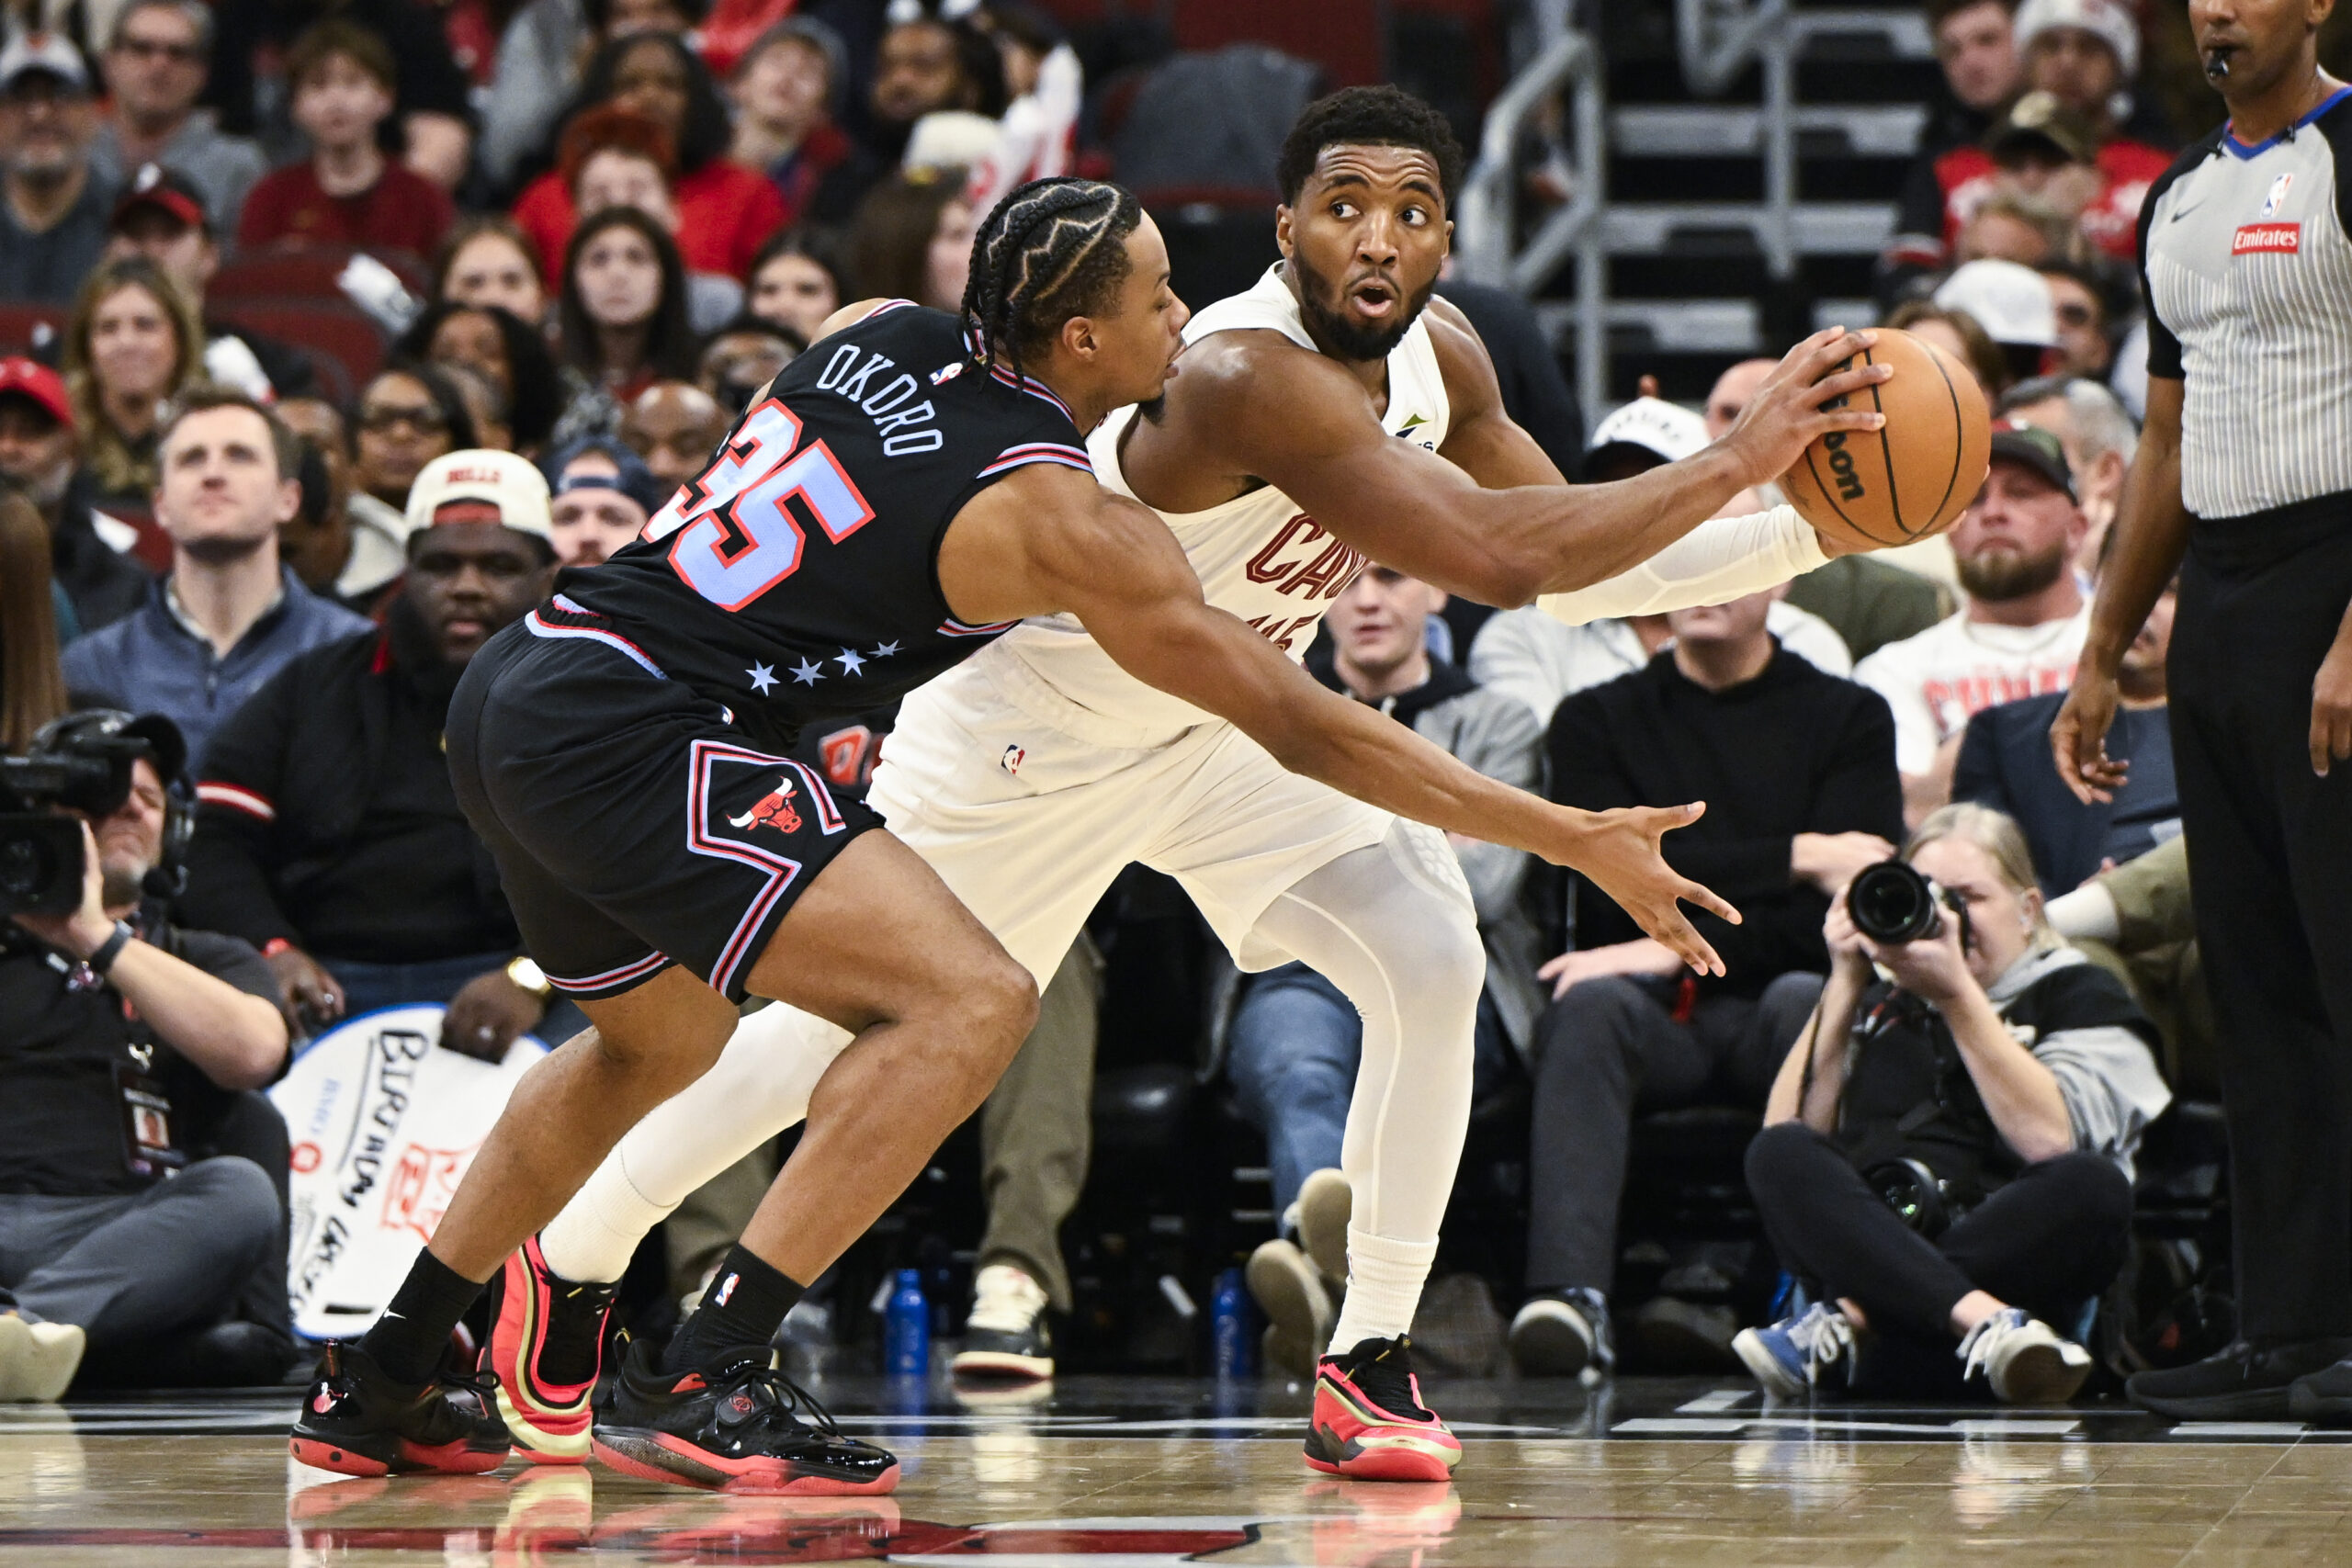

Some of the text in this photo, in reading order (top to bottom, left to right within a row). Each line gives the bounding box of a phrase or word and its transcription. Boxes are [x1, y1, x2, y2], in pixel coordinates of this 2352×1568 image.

[2233, 229, 2298, 250] Emirates
[816, 344, 944, 457] OKORO
[640, 397, 877, 613] 35
